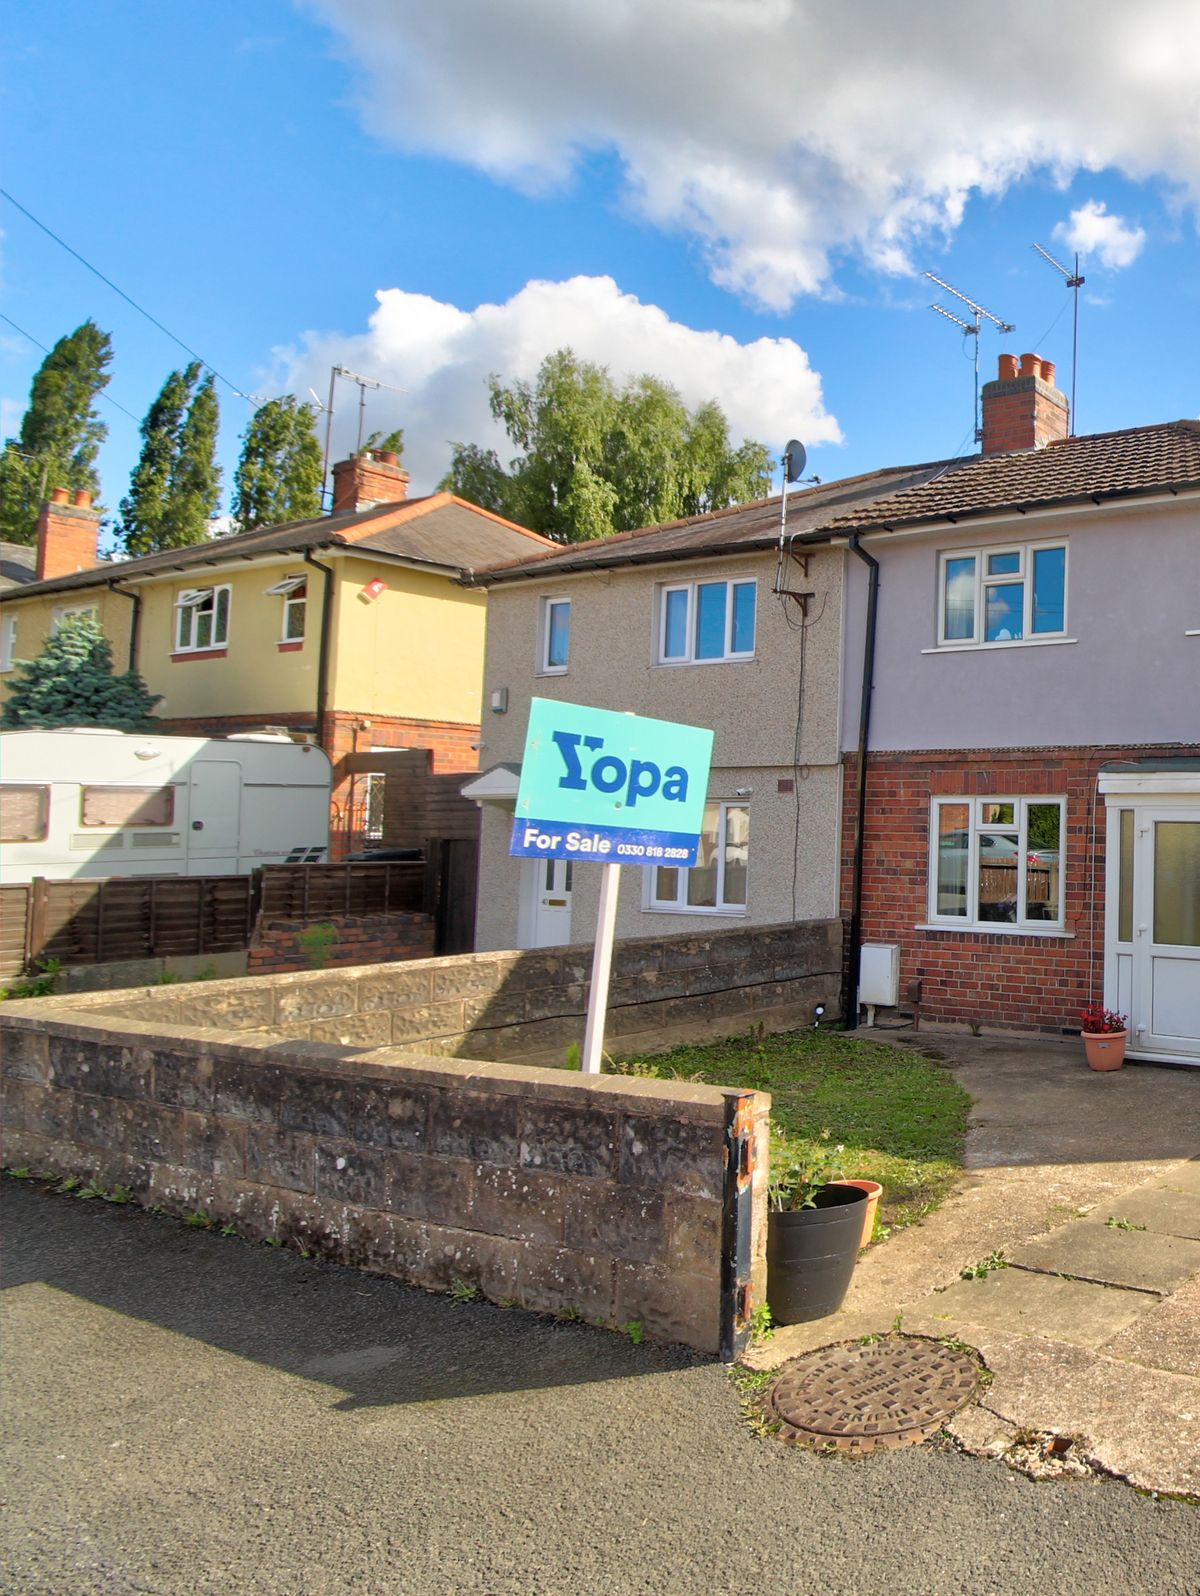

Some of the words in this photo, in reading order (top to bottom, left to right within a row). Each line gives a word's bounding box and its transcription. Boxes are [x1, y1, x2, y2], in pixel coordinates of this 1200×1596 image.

[552, 730, 689, 807] Yopa
[523, 828, 562, 849] For
[565, 832, 612, 854] Sale
[617, 844, 645, 856] 0330
[646, 847, 663, 857] 818
